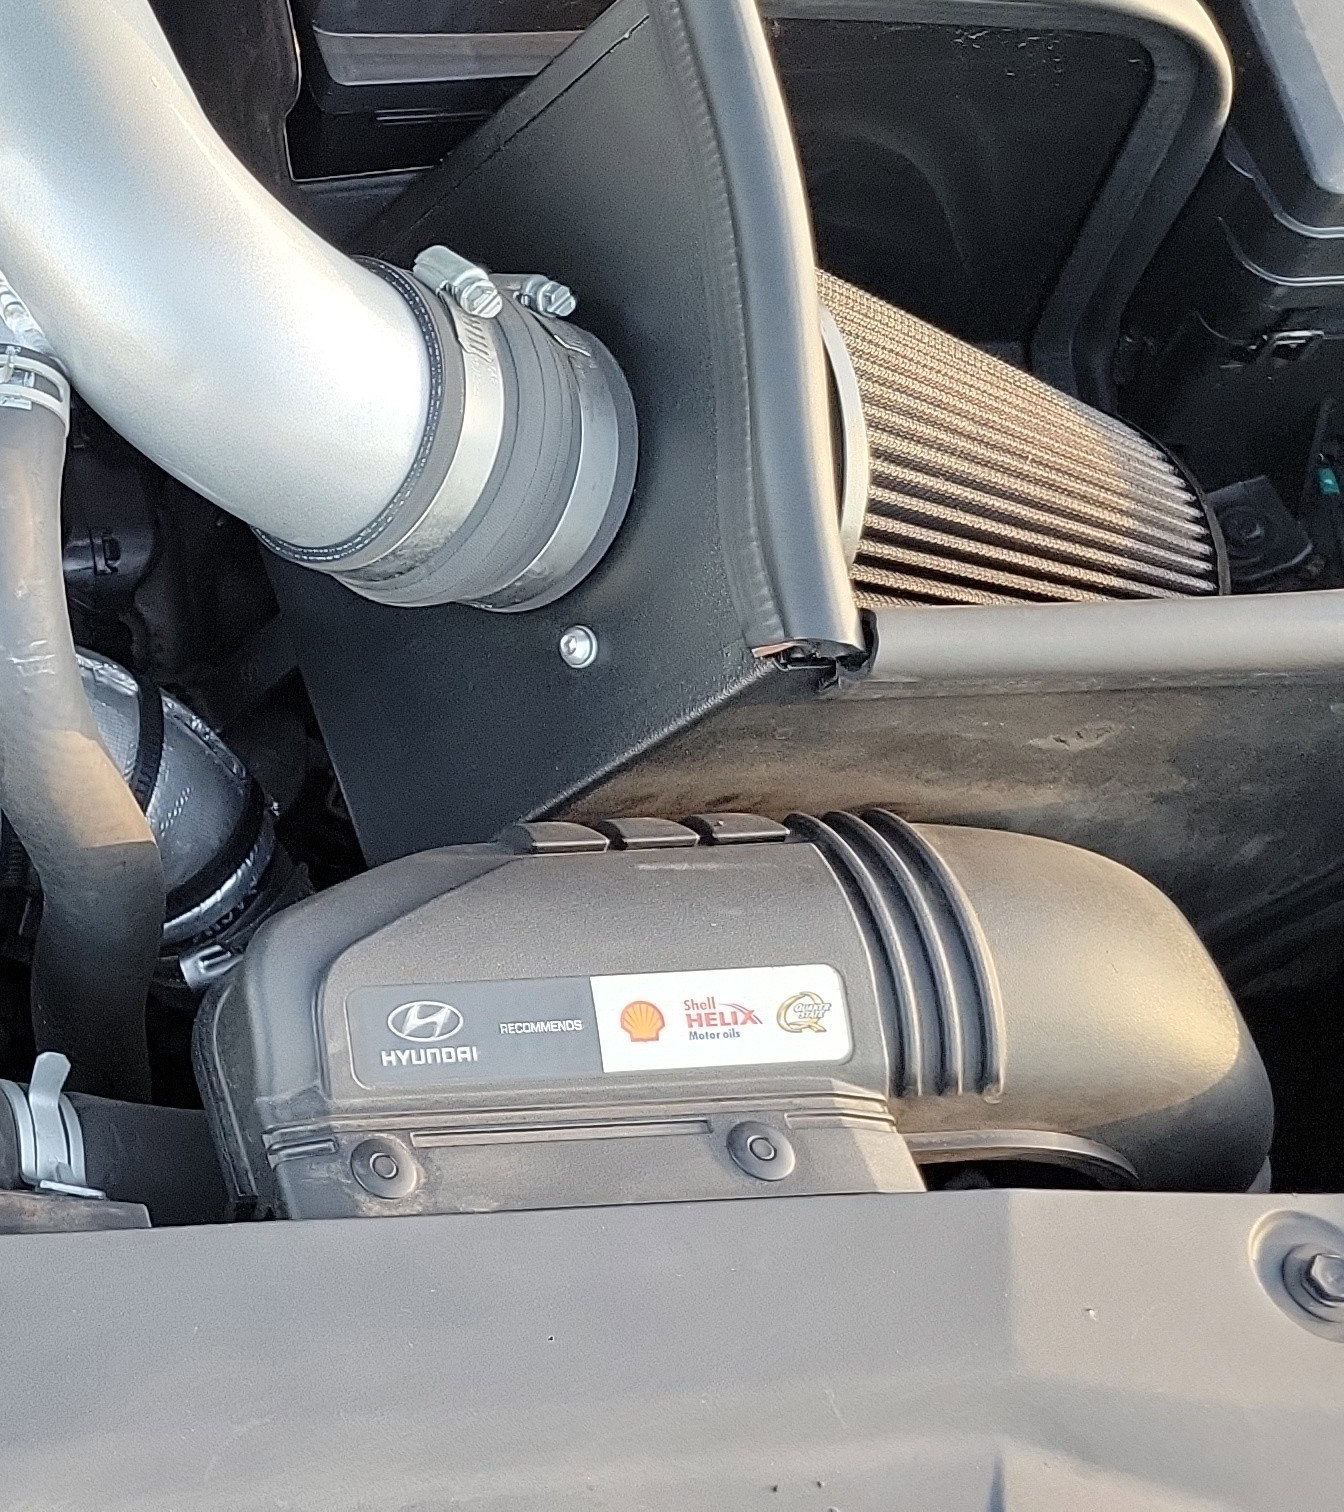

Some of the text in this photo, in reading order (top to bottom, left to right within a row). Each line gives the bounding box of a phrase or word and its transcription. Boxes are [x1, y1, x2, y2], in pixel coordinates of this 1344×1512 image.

[683, 996, 717, 1011] Shell
[685, 1008, 761, 1029] HELIX
[381, 1019, 583, 1067] HYUNDAI RECOMMENDS
[689, 1028, 741, 1041] Motor oils
